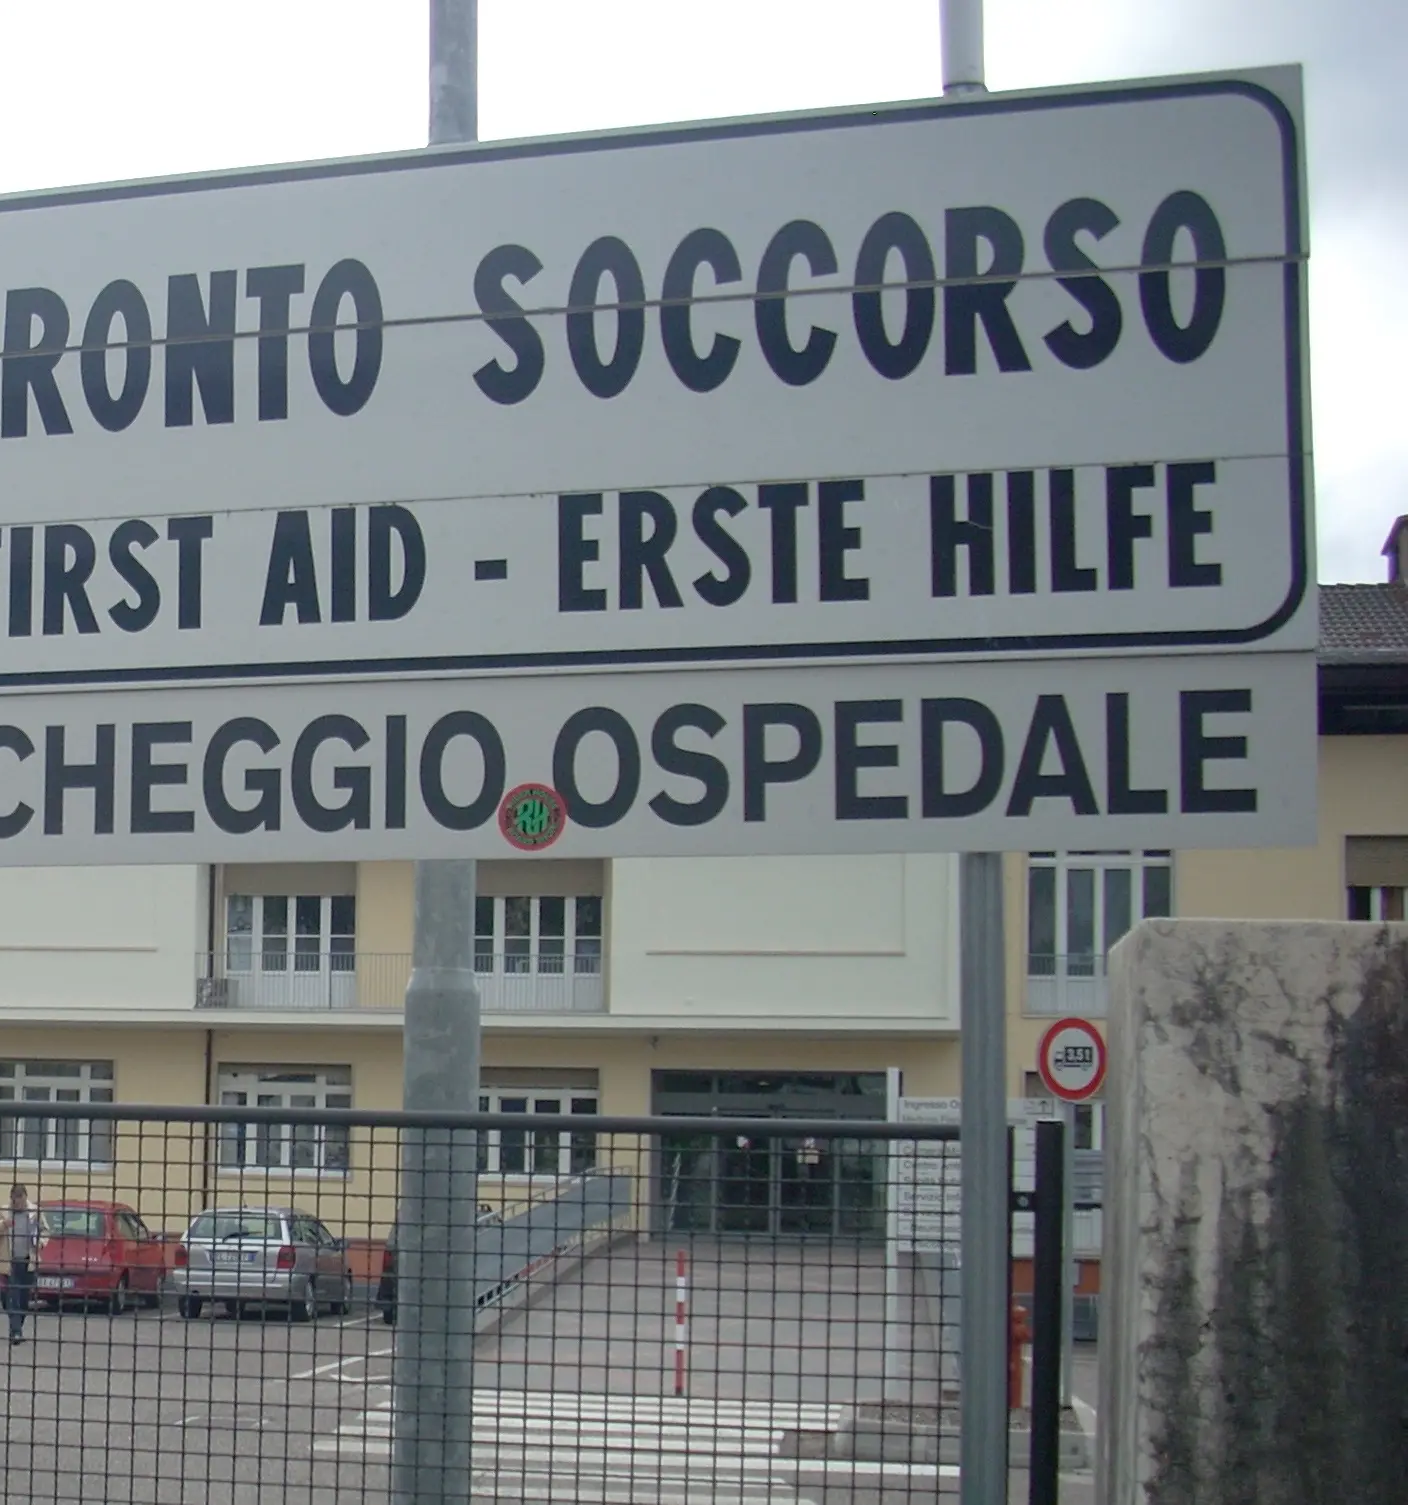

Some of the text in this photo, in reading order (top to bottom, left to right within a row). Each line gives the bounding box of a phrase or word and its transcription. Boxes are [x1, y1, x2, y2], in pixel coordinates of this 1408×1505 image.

[472, 189, 1227, 406] SOCCORSO
[259, 503, 426, 625] AID
[557, 479, 870, 612] ERSTE
[929, 461, 1223, 598] HILFE
[552, 688, 1259, 828] OSPEDALE
